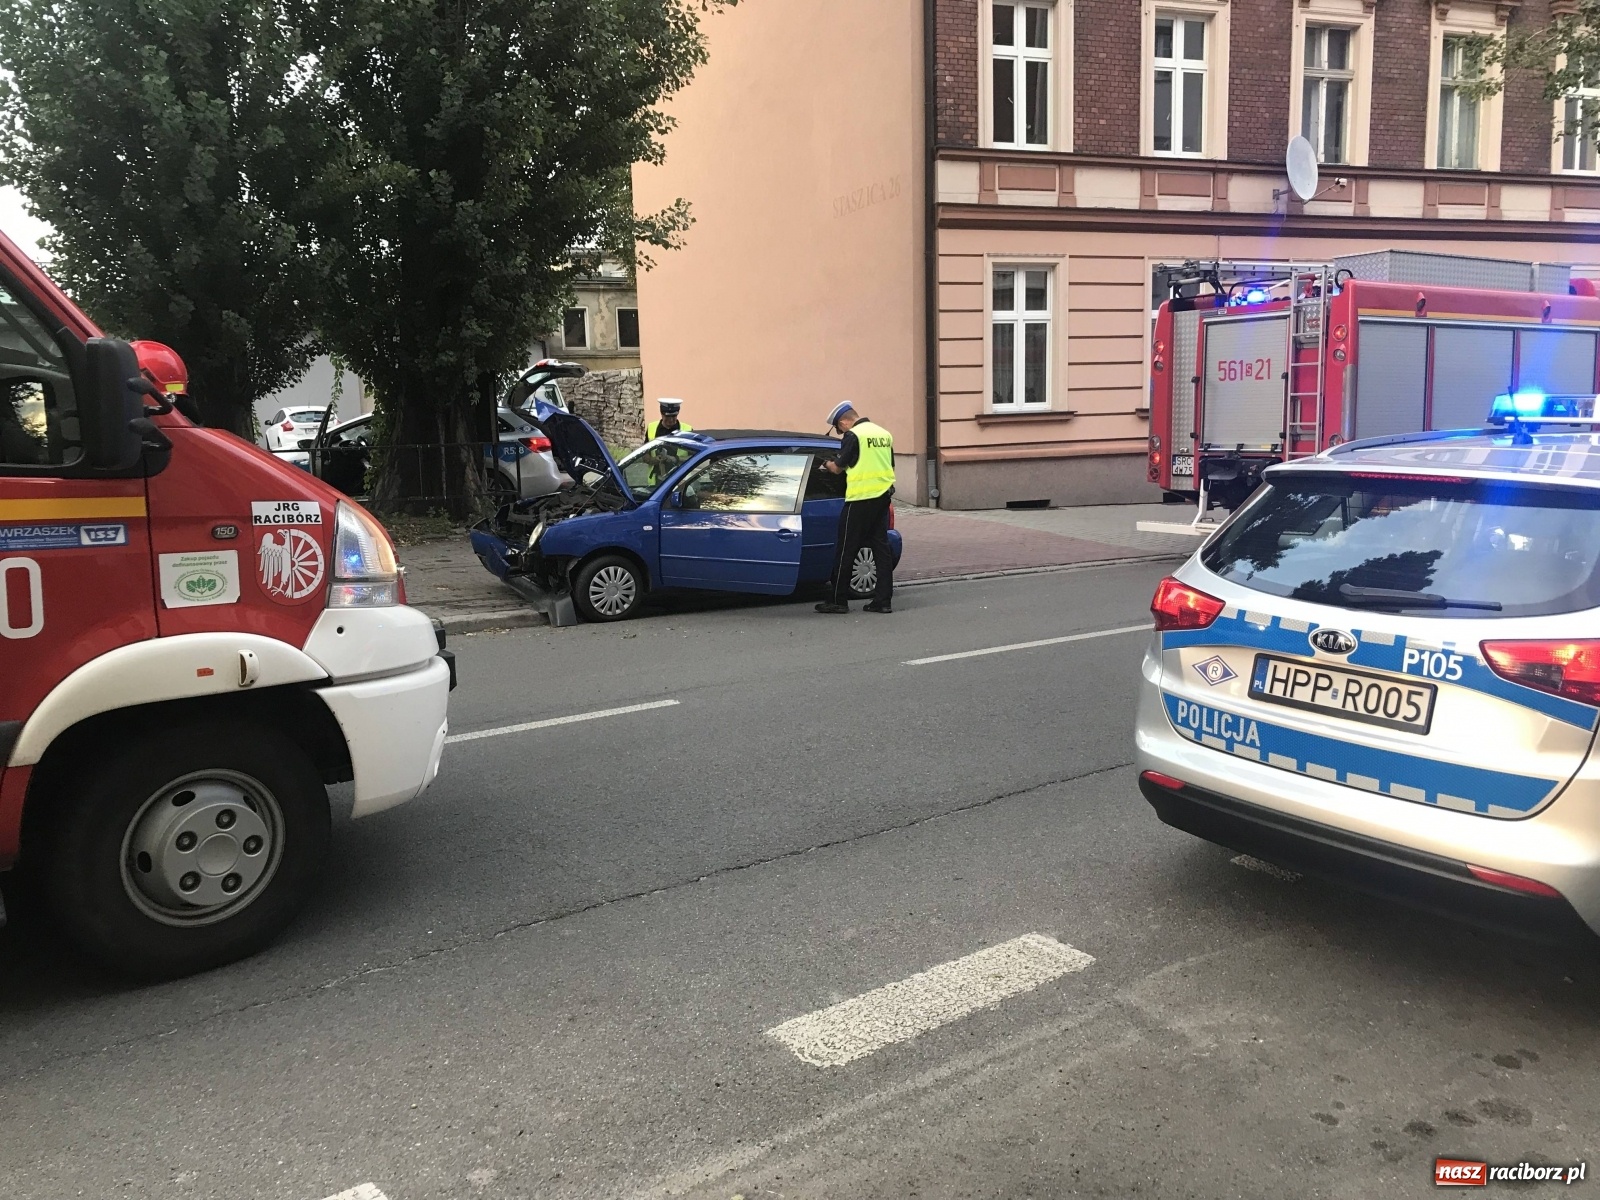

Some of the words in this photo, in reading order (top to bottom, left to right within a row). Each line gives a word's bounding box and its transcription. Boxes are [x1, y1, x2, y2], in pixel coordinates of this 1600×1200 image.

[833, 182, 887, 219] STASZICA
[504, 446, 525, 455] R58
[1177, 456, 1192, 465] SRC
[274, 502, 300, 512] JRG
[253, 512, 321, 524] RACIBÓRZ
[0, 526, 77, 538] WRZASZEK
[89, 530, 117, 540] ISS
[215, 526, 235, 535] 150
[1316, 632, 1347, 651] KIA
[1402, 648, 1464, 680] P105
[1211, 665, 1219, 676] R
[1253, 680, 1264, 690] PL
[1269, 664, 1333, 703] HPP
[1341, 678, 1425, 722] R005
[1177, 700, 1261, 747] POLICJA
